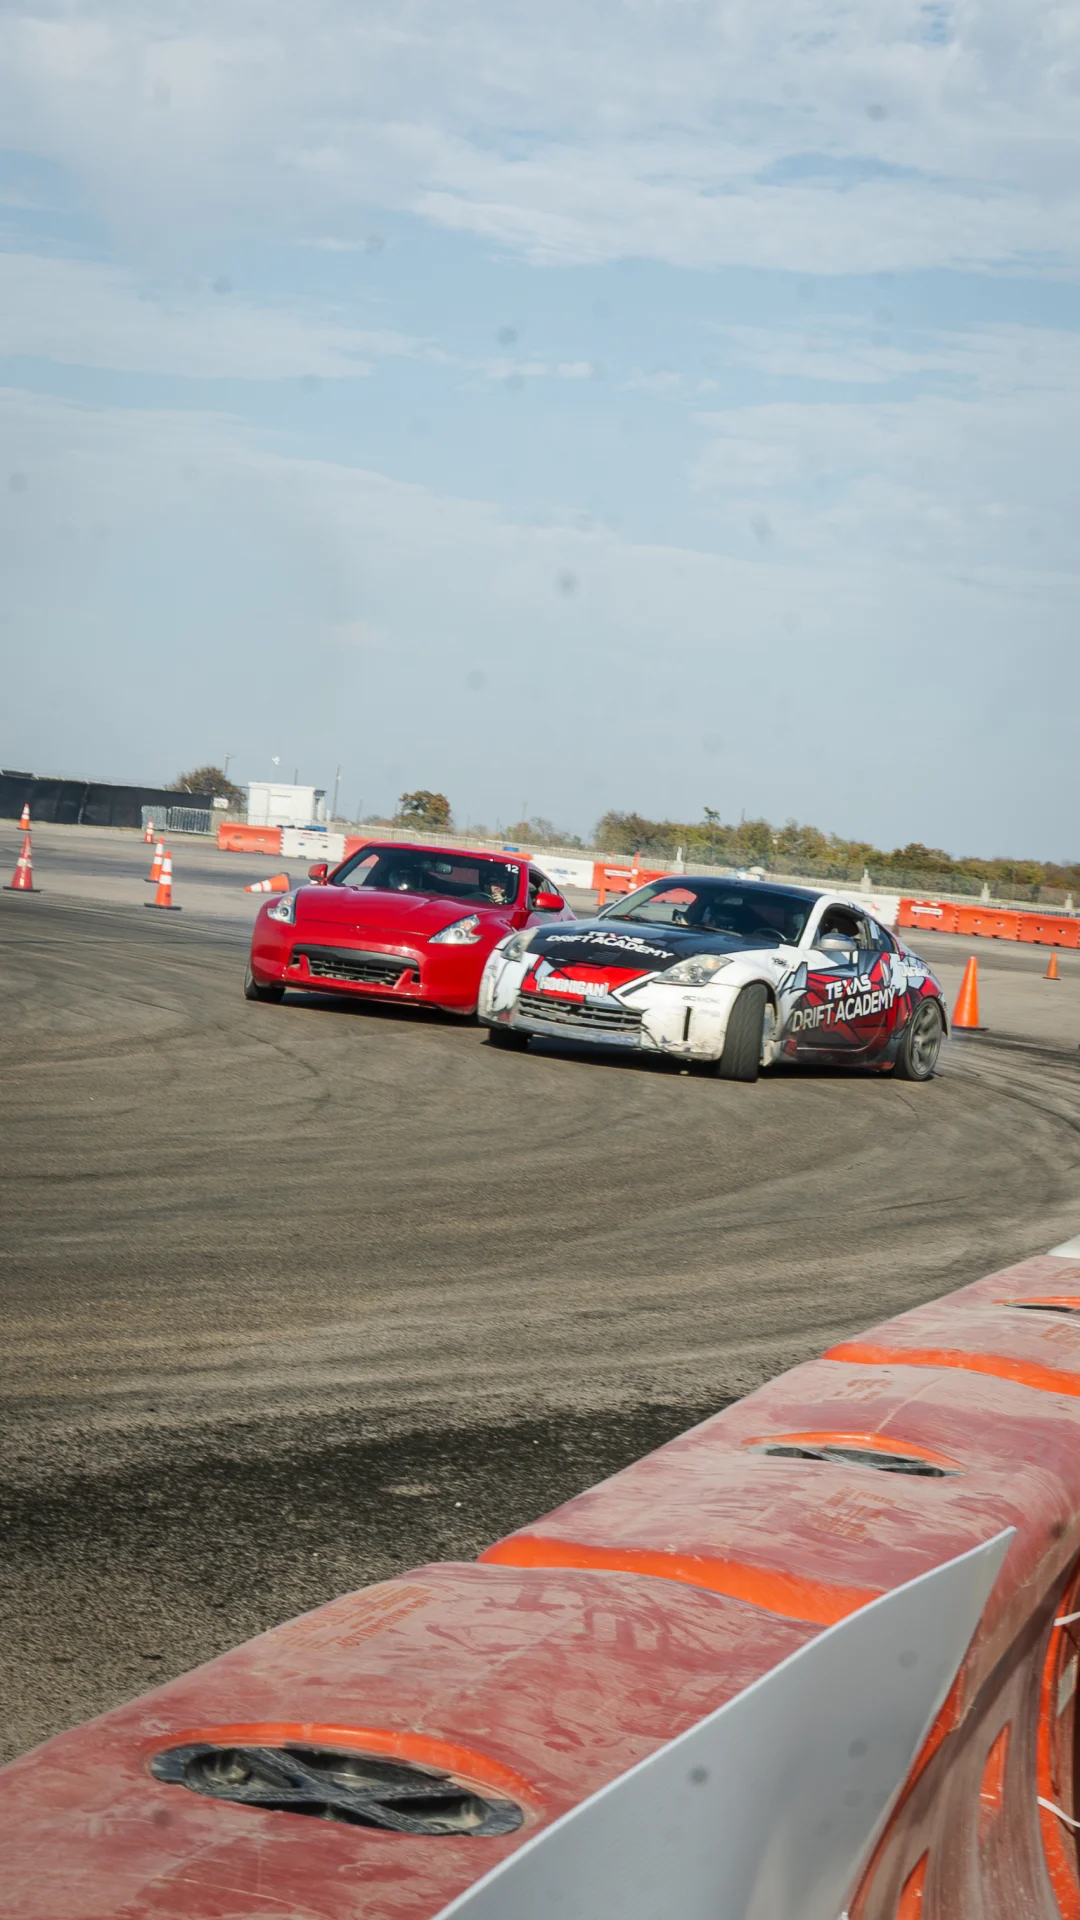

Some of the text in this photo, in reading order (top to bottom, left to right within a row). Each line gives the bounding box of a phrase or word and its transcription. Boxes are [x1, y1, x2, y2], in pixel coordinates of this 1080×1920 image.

[505, 863, 520, 874] 12
[545, 935, 675, 959] DRIFT ACADEMY
[825, 974, 872, 1000] TEXAS
[792, 986, 896, 1032] DRIFT ACADEMY
